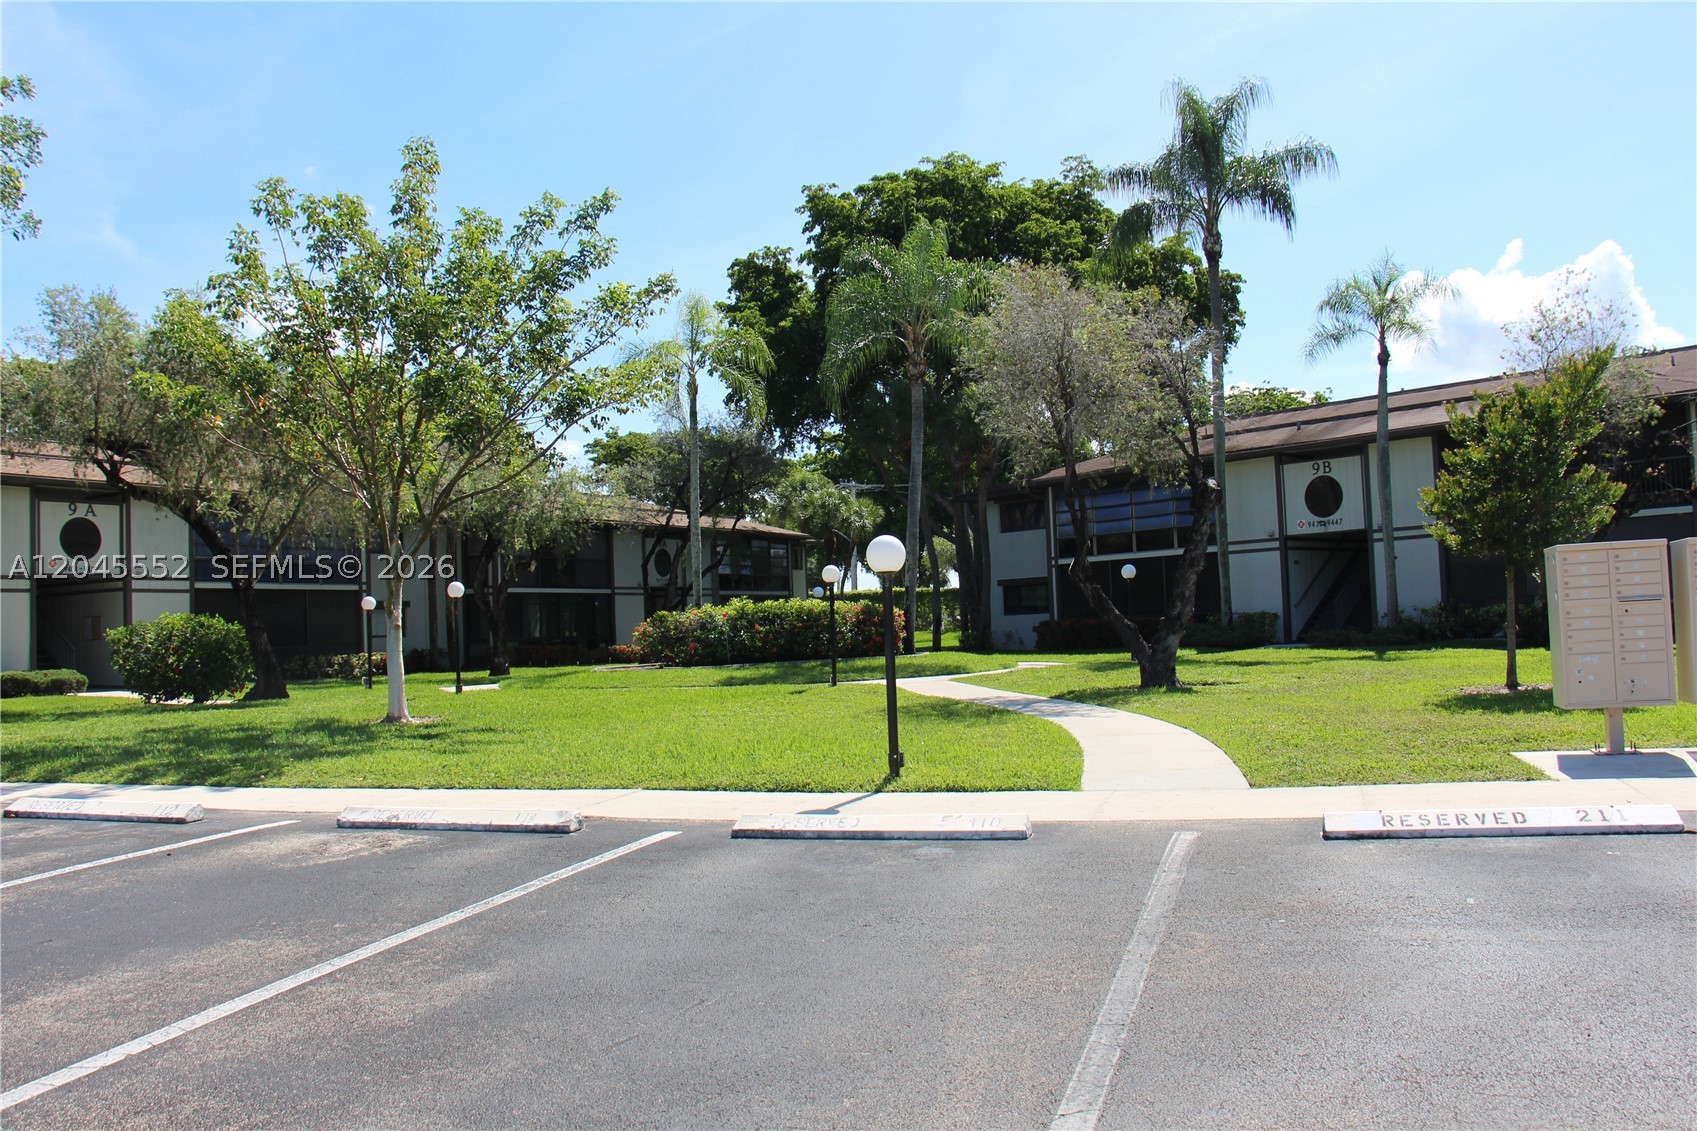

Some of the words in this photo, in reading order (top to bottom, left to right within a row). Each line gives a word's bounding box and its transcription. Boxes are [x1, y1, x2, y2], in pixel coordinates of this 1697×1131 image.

[1312, 461, 1332, 475] 9B
[1381, 811, 1528, 828] RESERVED
[1575, 809, 1629, 823] 211
